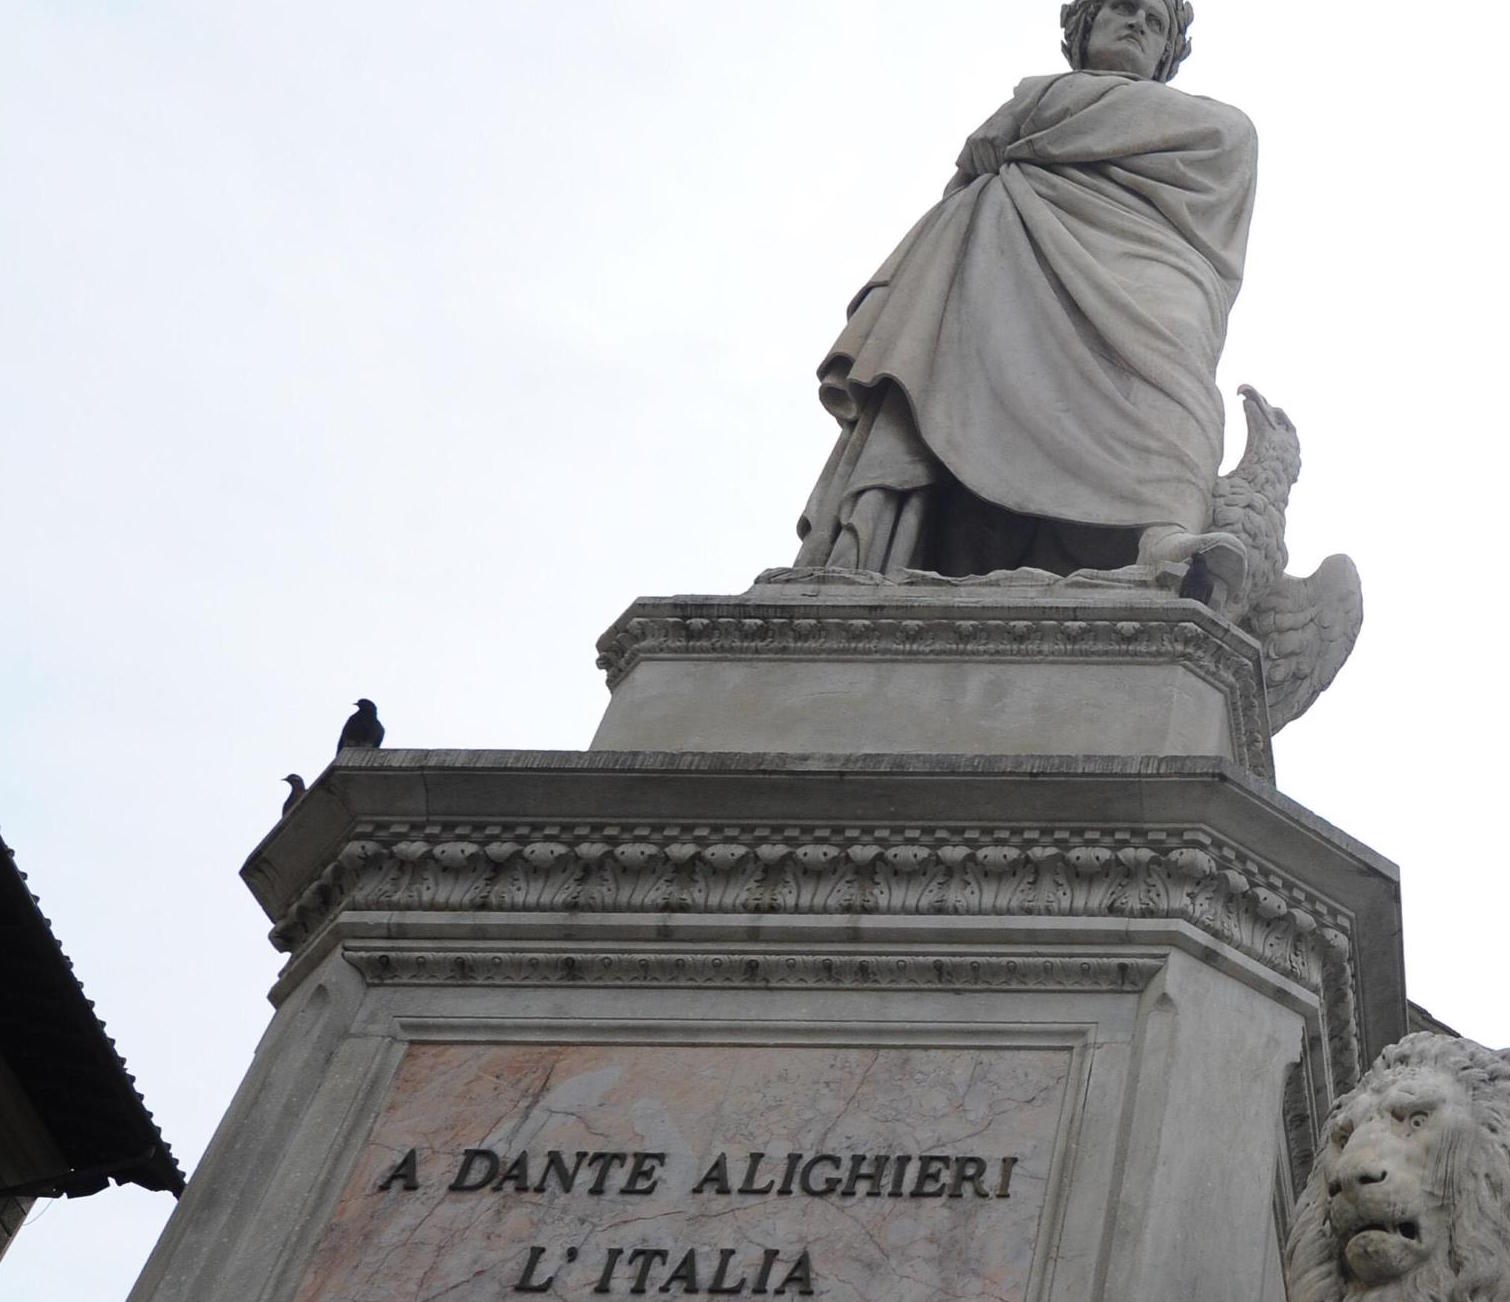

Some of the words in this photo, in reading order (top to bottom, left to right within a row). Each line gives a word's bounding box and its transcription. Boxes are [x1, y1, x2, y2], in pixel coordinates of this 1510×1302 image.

[378, 1148, 419, 1191] A
[448, 1148, 667, 1195] DANTE
[691, 1152, 1019, 1198] ALIGHIERI
